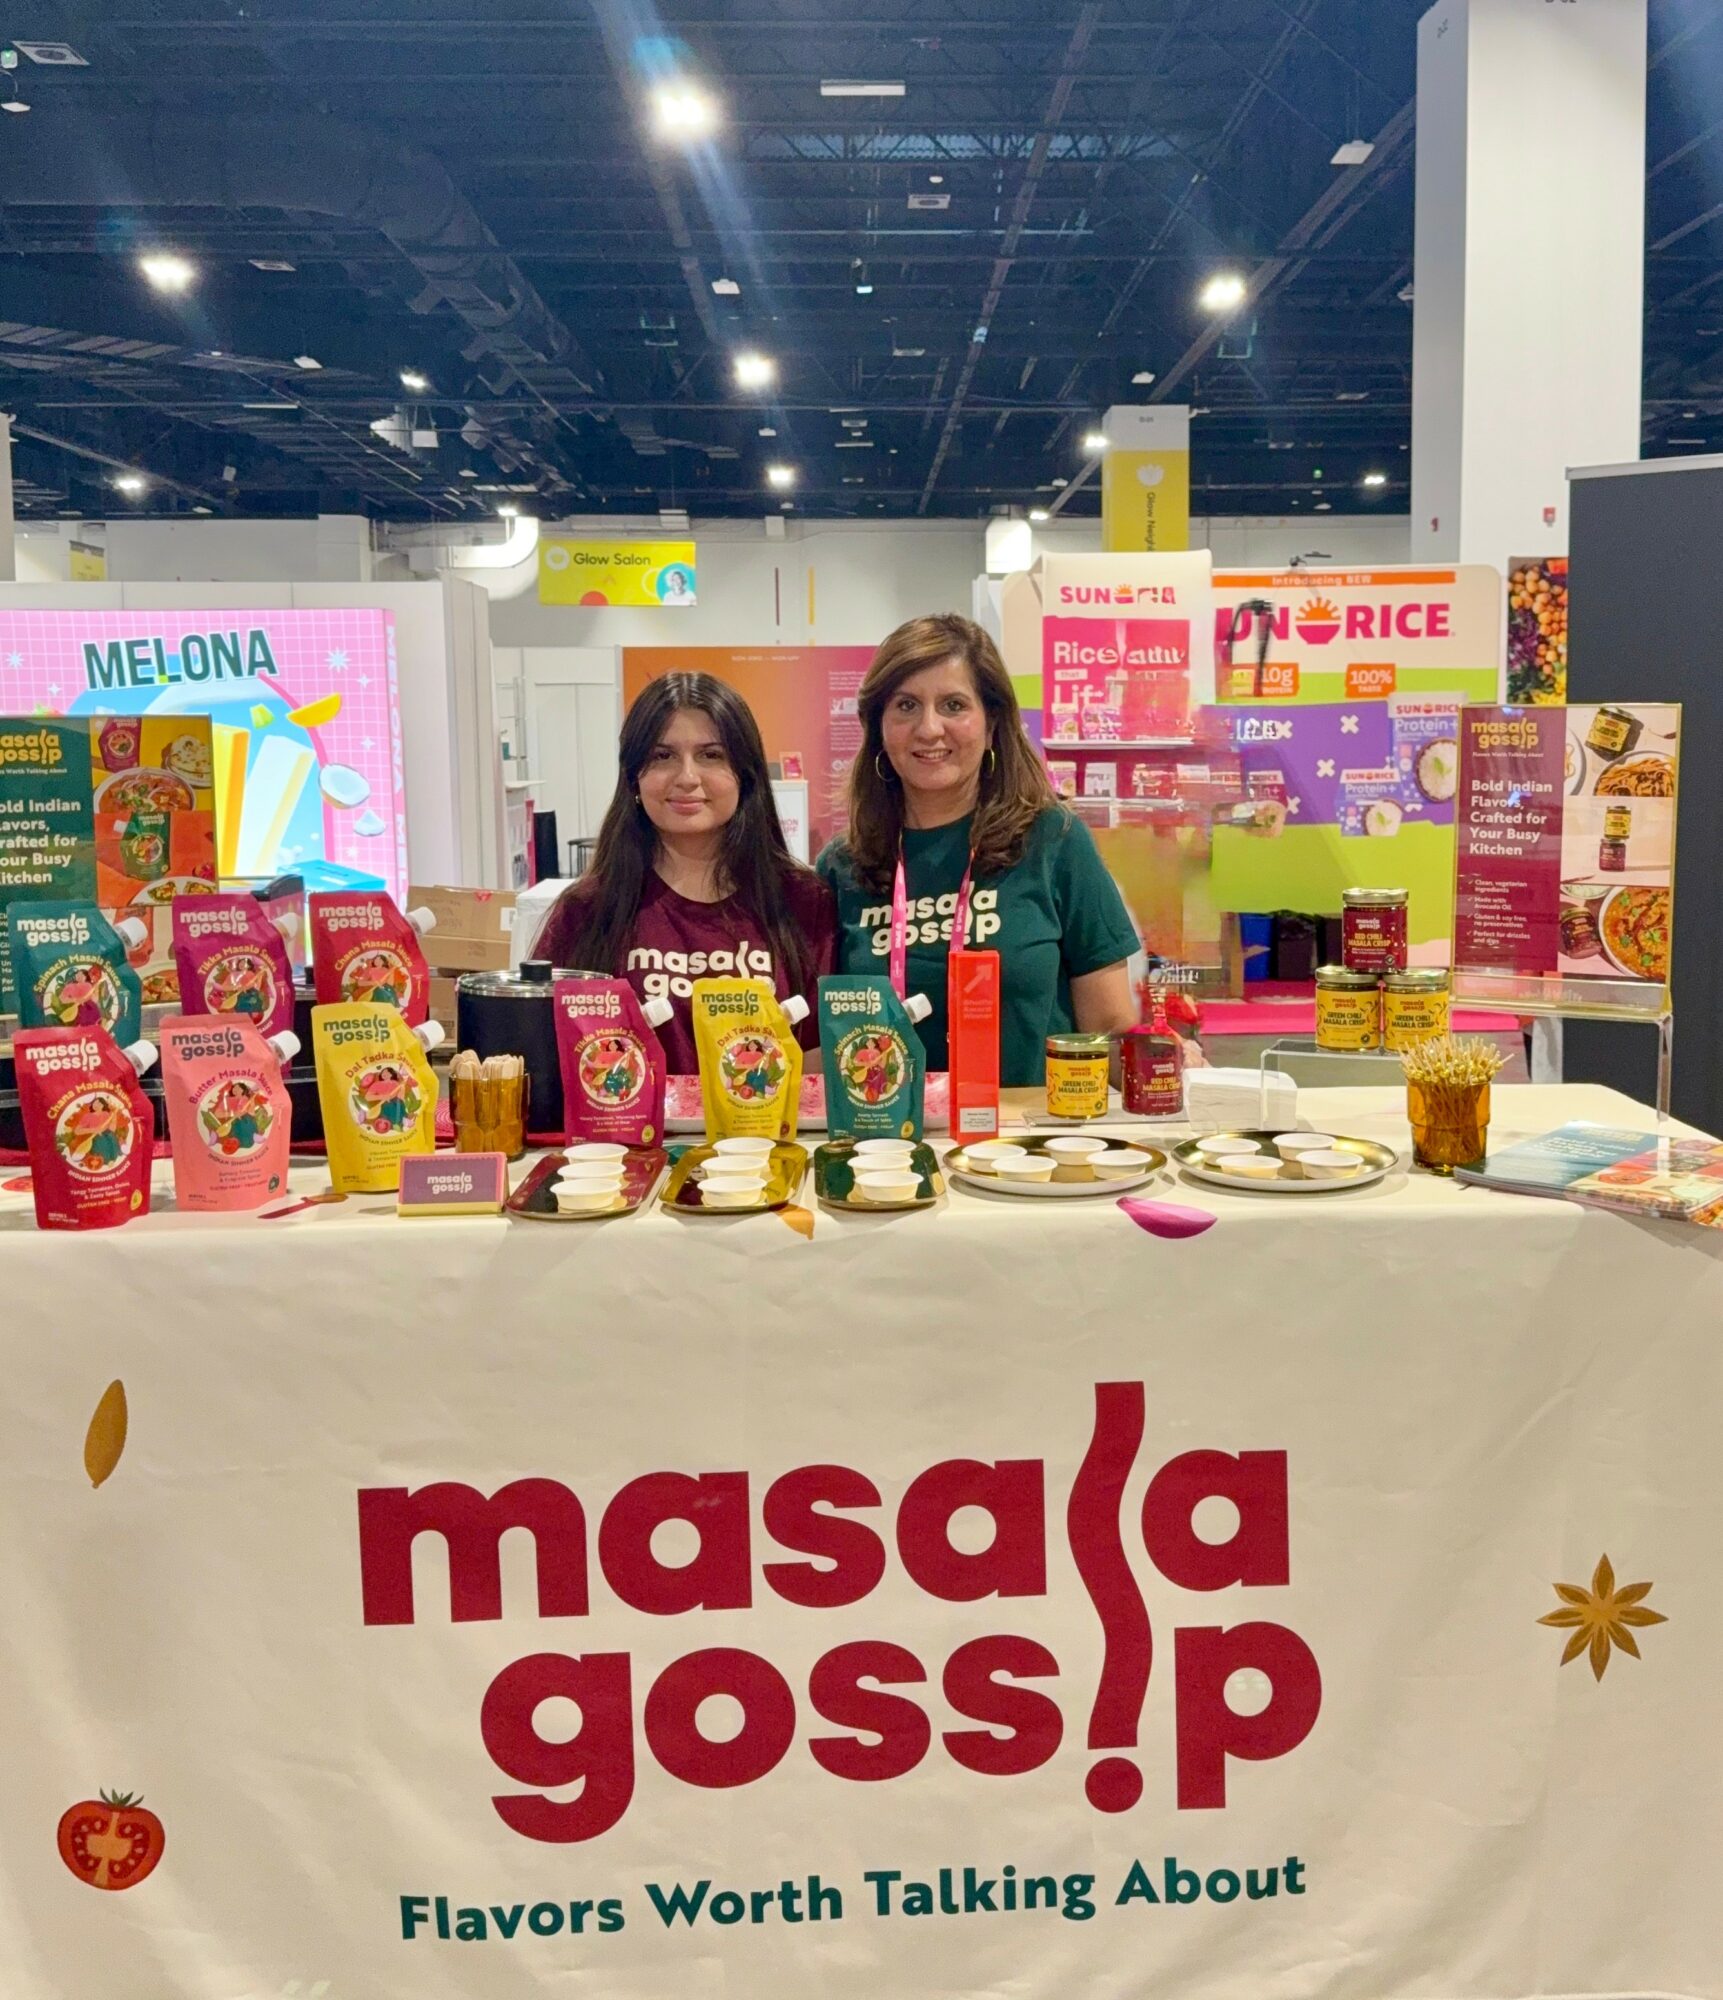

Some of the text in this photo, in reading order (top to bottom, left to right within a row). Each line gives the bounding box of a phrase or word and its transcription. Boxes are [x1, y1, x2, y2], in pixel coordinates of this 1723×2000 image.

[1147, 492, 1156, 517] Glow
[574, 552, 651, 566] Glow Salon
[1272, 576, 1342, 586] Introducing
[1060, 586, 1111, 605] SUN
[1345, 603, 1450, 639] RICE
[84, 630, 278, 690] MELONA
[1054, 641, 1119, 665] Rice
[1350, 669, 1393, 685] 100%
[1396, 705, 1421, 714] SUN
[1471, 717, 1537, 733] masala
[0, 729, 60, 748] asala
[1478, 733, 1539, 750] gossip
[1472, 780, 1553, 793] Bold Indian
[0, 799, 81, 813] old Indian
[0, 819, 50, 832] avors,
[1470, 812, 1547, 825] Crafted for
[0, 834, 78, 848] rafted for
[1470, 828, 1541, 844] Your Busy
[1469, 843, 1523, 856] Kitchen
[0, 854, 72, 868] our Busy
[0, 871, 52, 885] itchen
[180, 906, 246, 923] masala
[319, 902, 382, 918] masala
[17, 913, 88, 931] masala
[189, 921, 249, 938] gossip
[328, 916, 384, 932] gossip
[26, 930, 91, 947] gossip
[361, 940, 397, 951] Masala
[224, 943, 260, 955] Masala
[627, 940, 773, 975] masala
[34, 958, 68, 993] Spinach
[68, 954, 104, 965] Masala
[103, 958, 122, 987] Sauce
[562, 990, 620, 1005] masala
[701, 989, 759, 1004] masala
[825, 987, 881, 1002] masala
[568, 1003, 622, 1019] gossip
[708, 1001, 760, 1016] gossip
[831, 1000, 882, 1015] gossip
[324, 1014, 389, 1032] masala
[172, 1027, 242, 1046] masala
[332, 1030, 391, 1046] gossip
[717, 1025, 761, 1048] Dal Tadka
[26, 1038, 99, 1060] masala
[181, 1043, 245, 1061] gossip
[36, 1054, 102, 1076] gossip
[345, 1051, 395, 1079] Dal Tadka
[189, 1076, 217, 1105] Butter
[219, 1069, 257, 1079] Masala
[47, 1090, 76, 1120] Chana
[75, 1079, 115, 1093] Masala
[427, 1172, 472, 1184] masala
[432, 1182, 473, 1195] gossip
[357, 1381, 1290, 1625] masala
[480, 1615, 1322, 1843] gossip
[400, 1854, 1306, 1941] Flavors Worth Talking About
